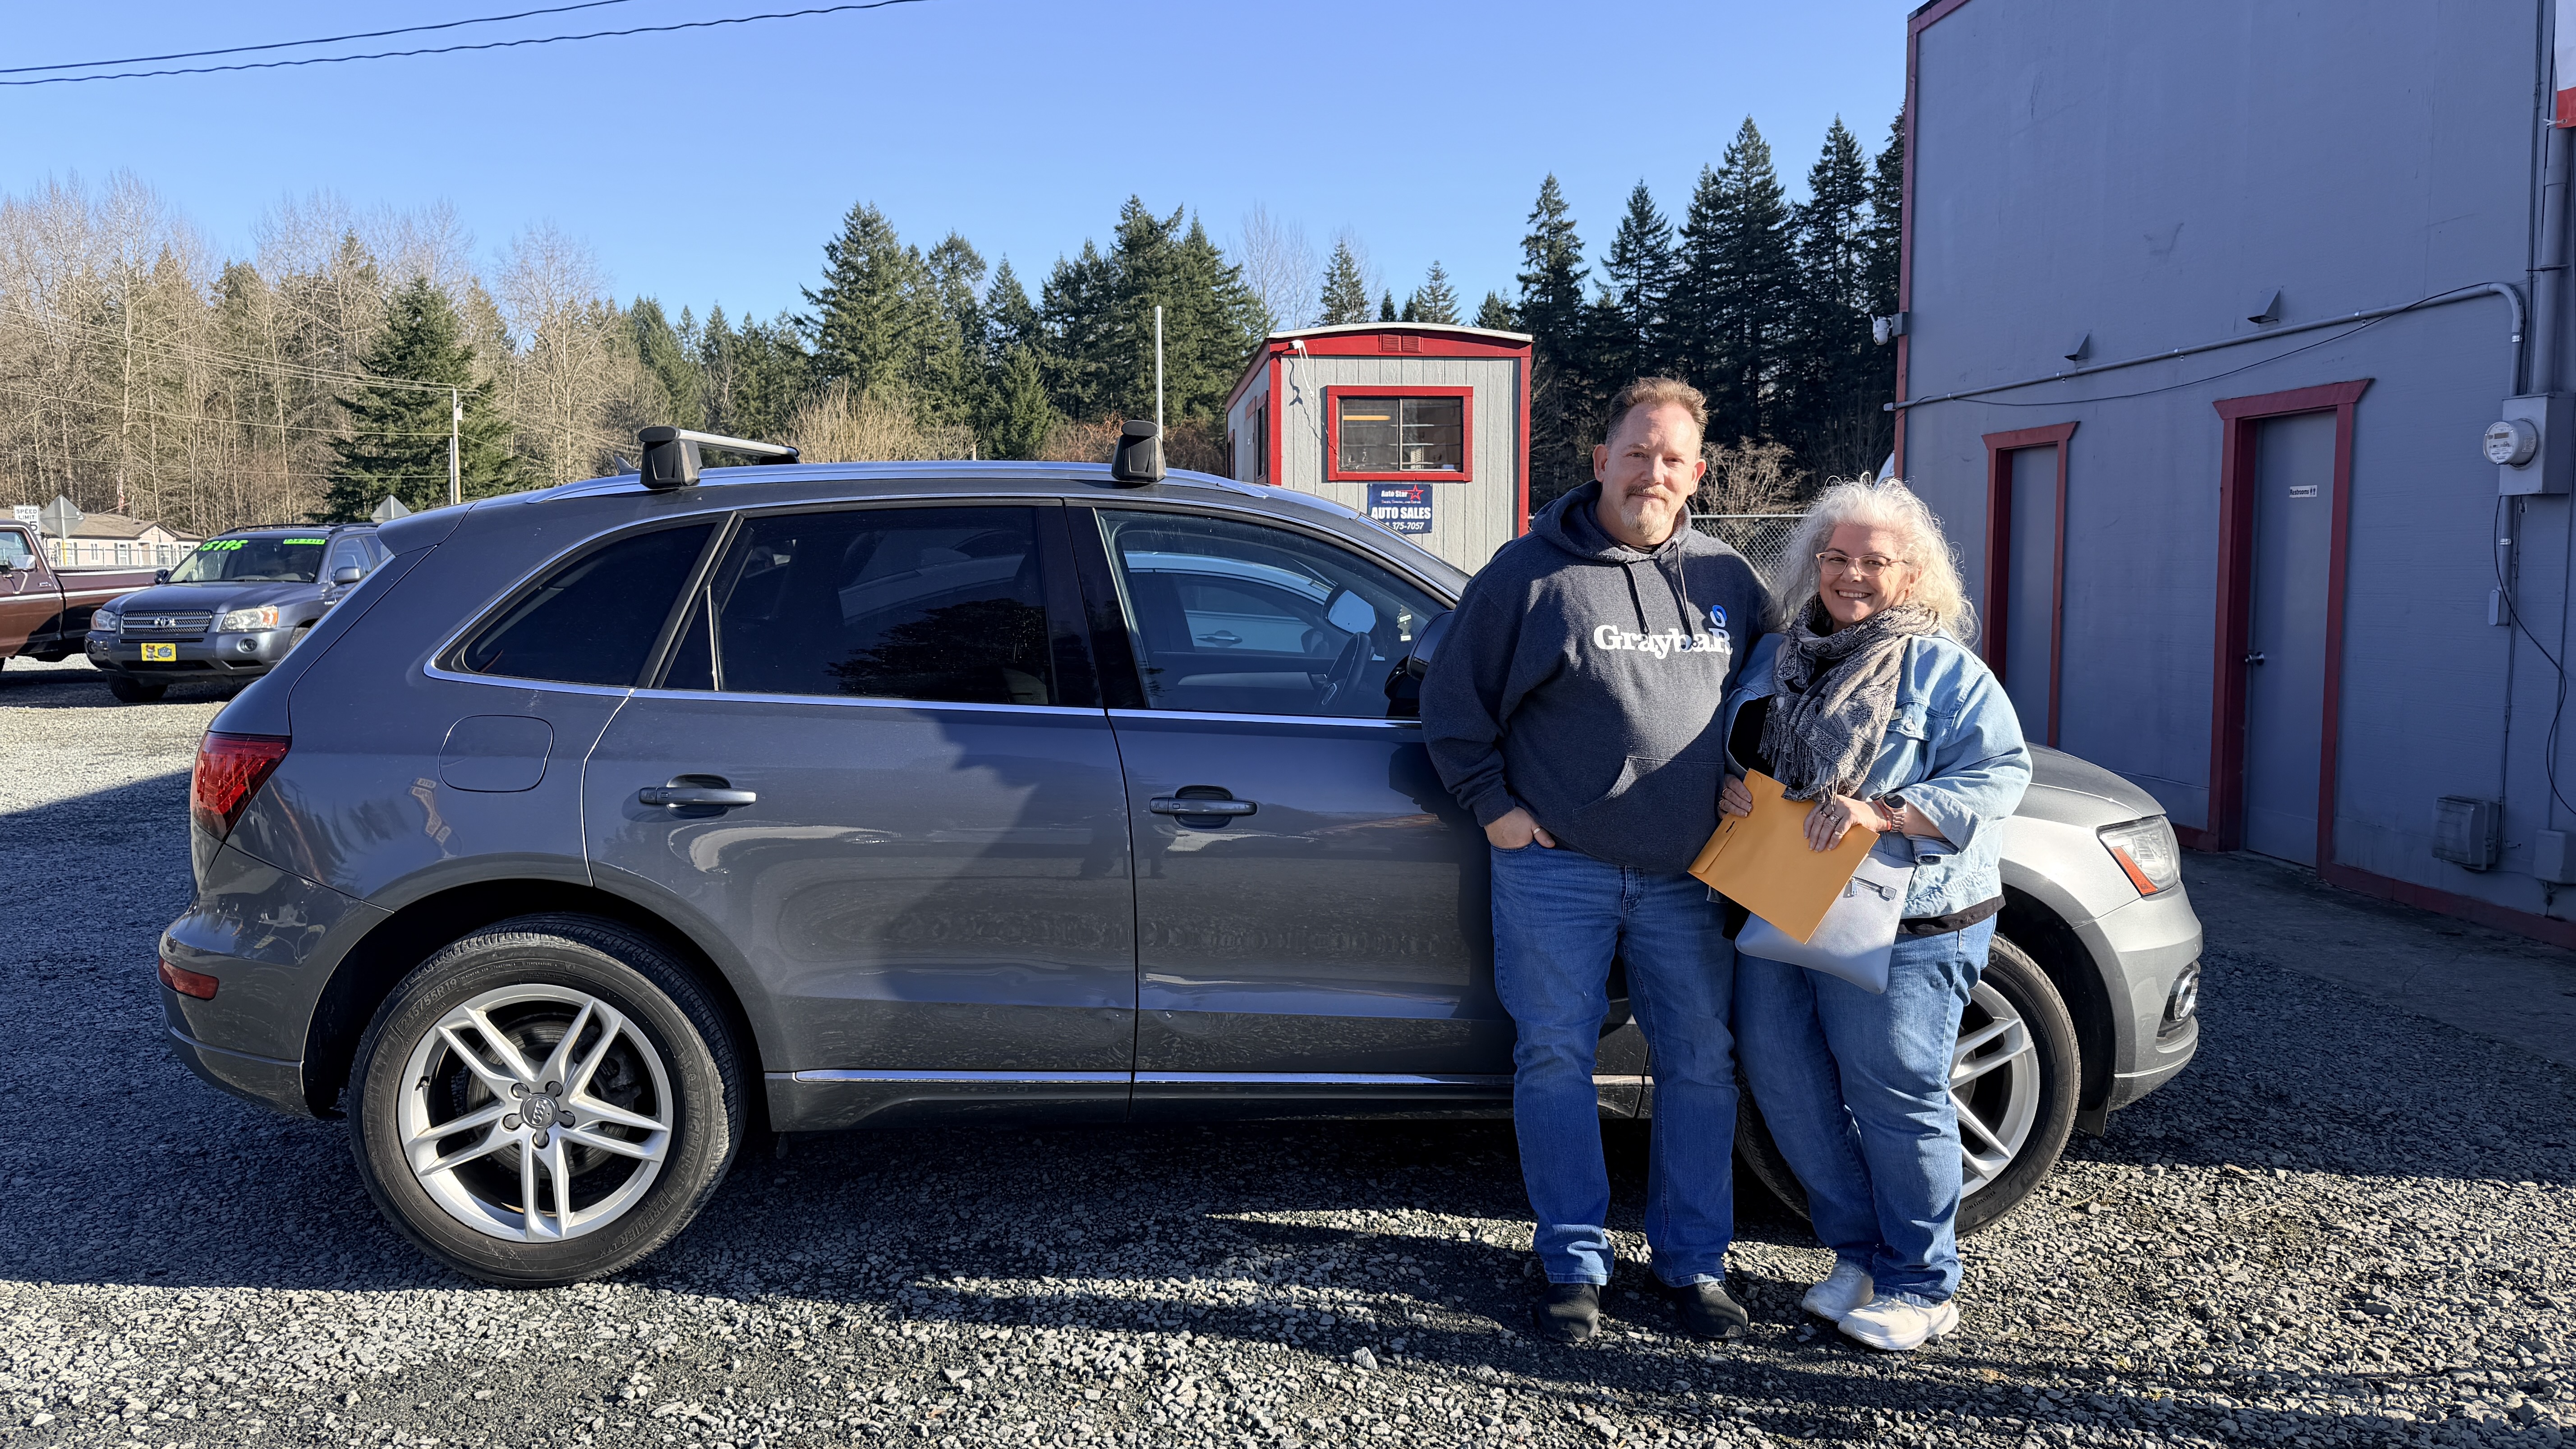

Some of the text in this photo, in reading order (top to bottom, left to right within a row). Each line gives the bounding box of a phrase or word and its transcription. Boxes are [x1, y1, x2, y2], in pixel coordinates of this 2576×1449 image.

[29, 521, 38, 531] 5
[1371, 506, 1431, 520] AUTO SALES
[400, 978, 457, 1030] 235/55R19
[366, 1035, 398, 1141] MICHELIN
[670, 1090, 700, 1193] MICHELIN
[2021, 1100, 2064, 1184] MICHELIN
[620, 1200, 666, 1244] PREMIER
[600, 1243, 617, 1257] LTX
